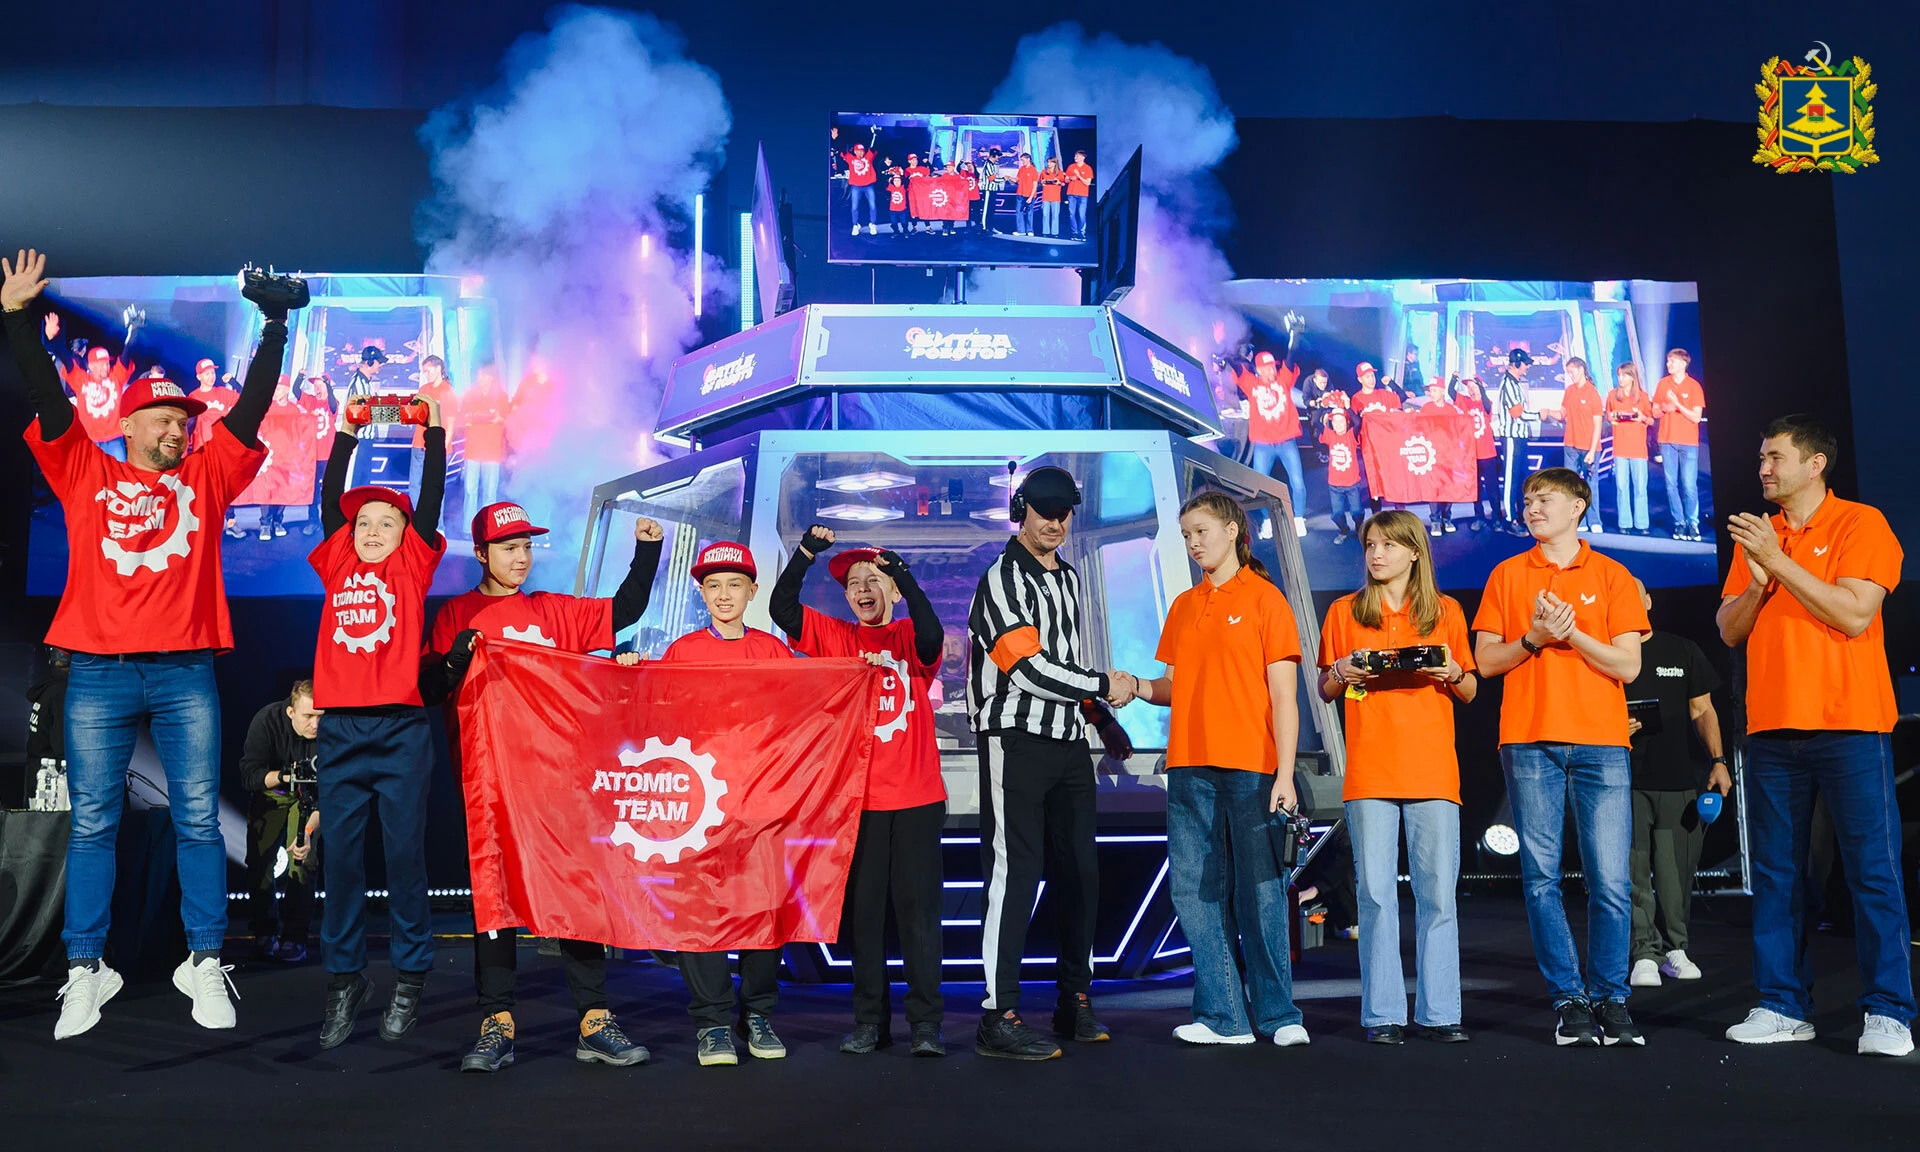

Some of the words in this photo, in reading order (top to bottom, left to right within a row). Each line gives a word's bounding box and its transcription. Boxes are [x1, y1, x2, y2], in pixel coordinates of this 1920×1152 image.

[336, 608, 377, 626] TEAM
[592, 770, 690, 793] ATOMIC
[614, 799, 689, 823] TEAM
